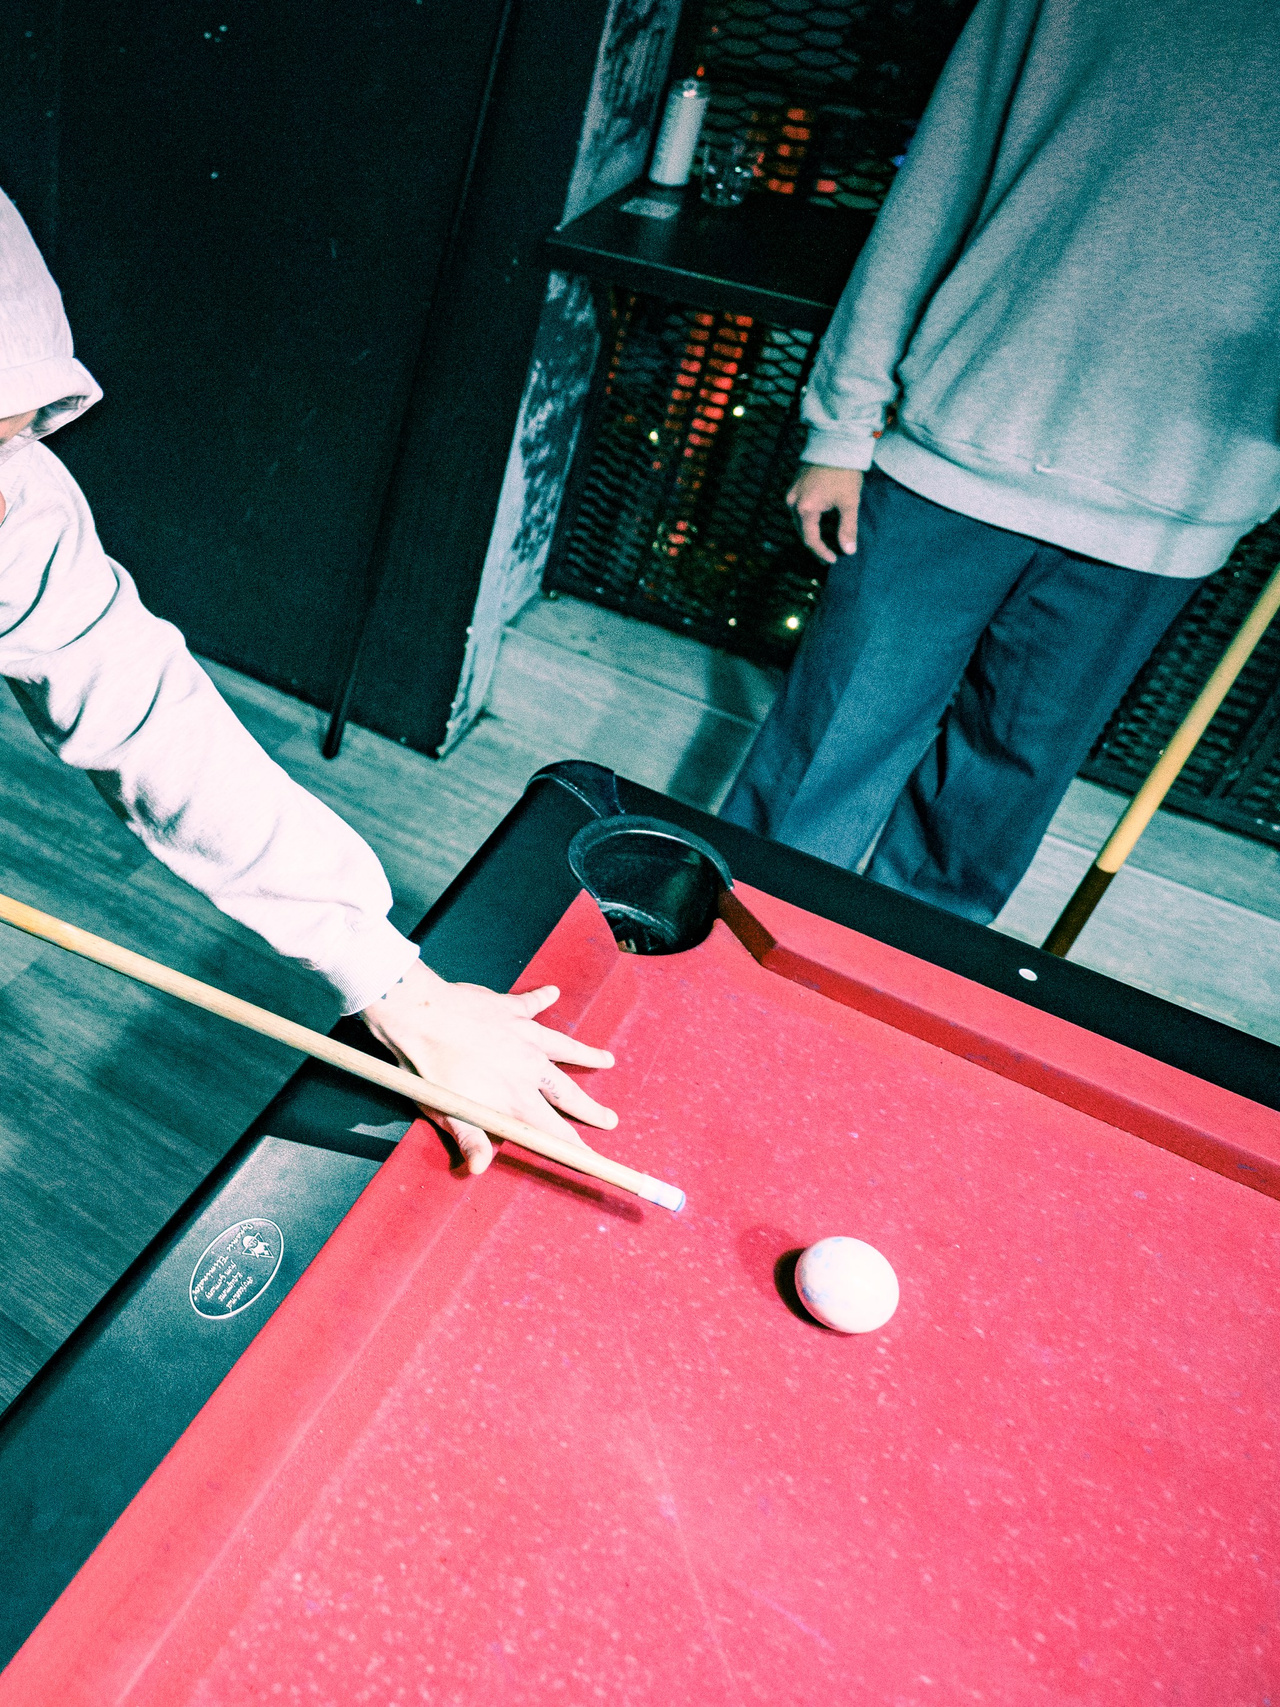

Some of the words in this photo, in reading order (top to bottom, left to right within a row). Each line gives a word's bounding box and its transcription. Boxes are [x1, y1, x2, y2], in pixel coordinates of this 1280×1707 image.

[227, 1223, 253, 1252] Dynamic
[205, 1273, 227, 1299] Germany
[217, 1271, 243, 1301] Equipment
